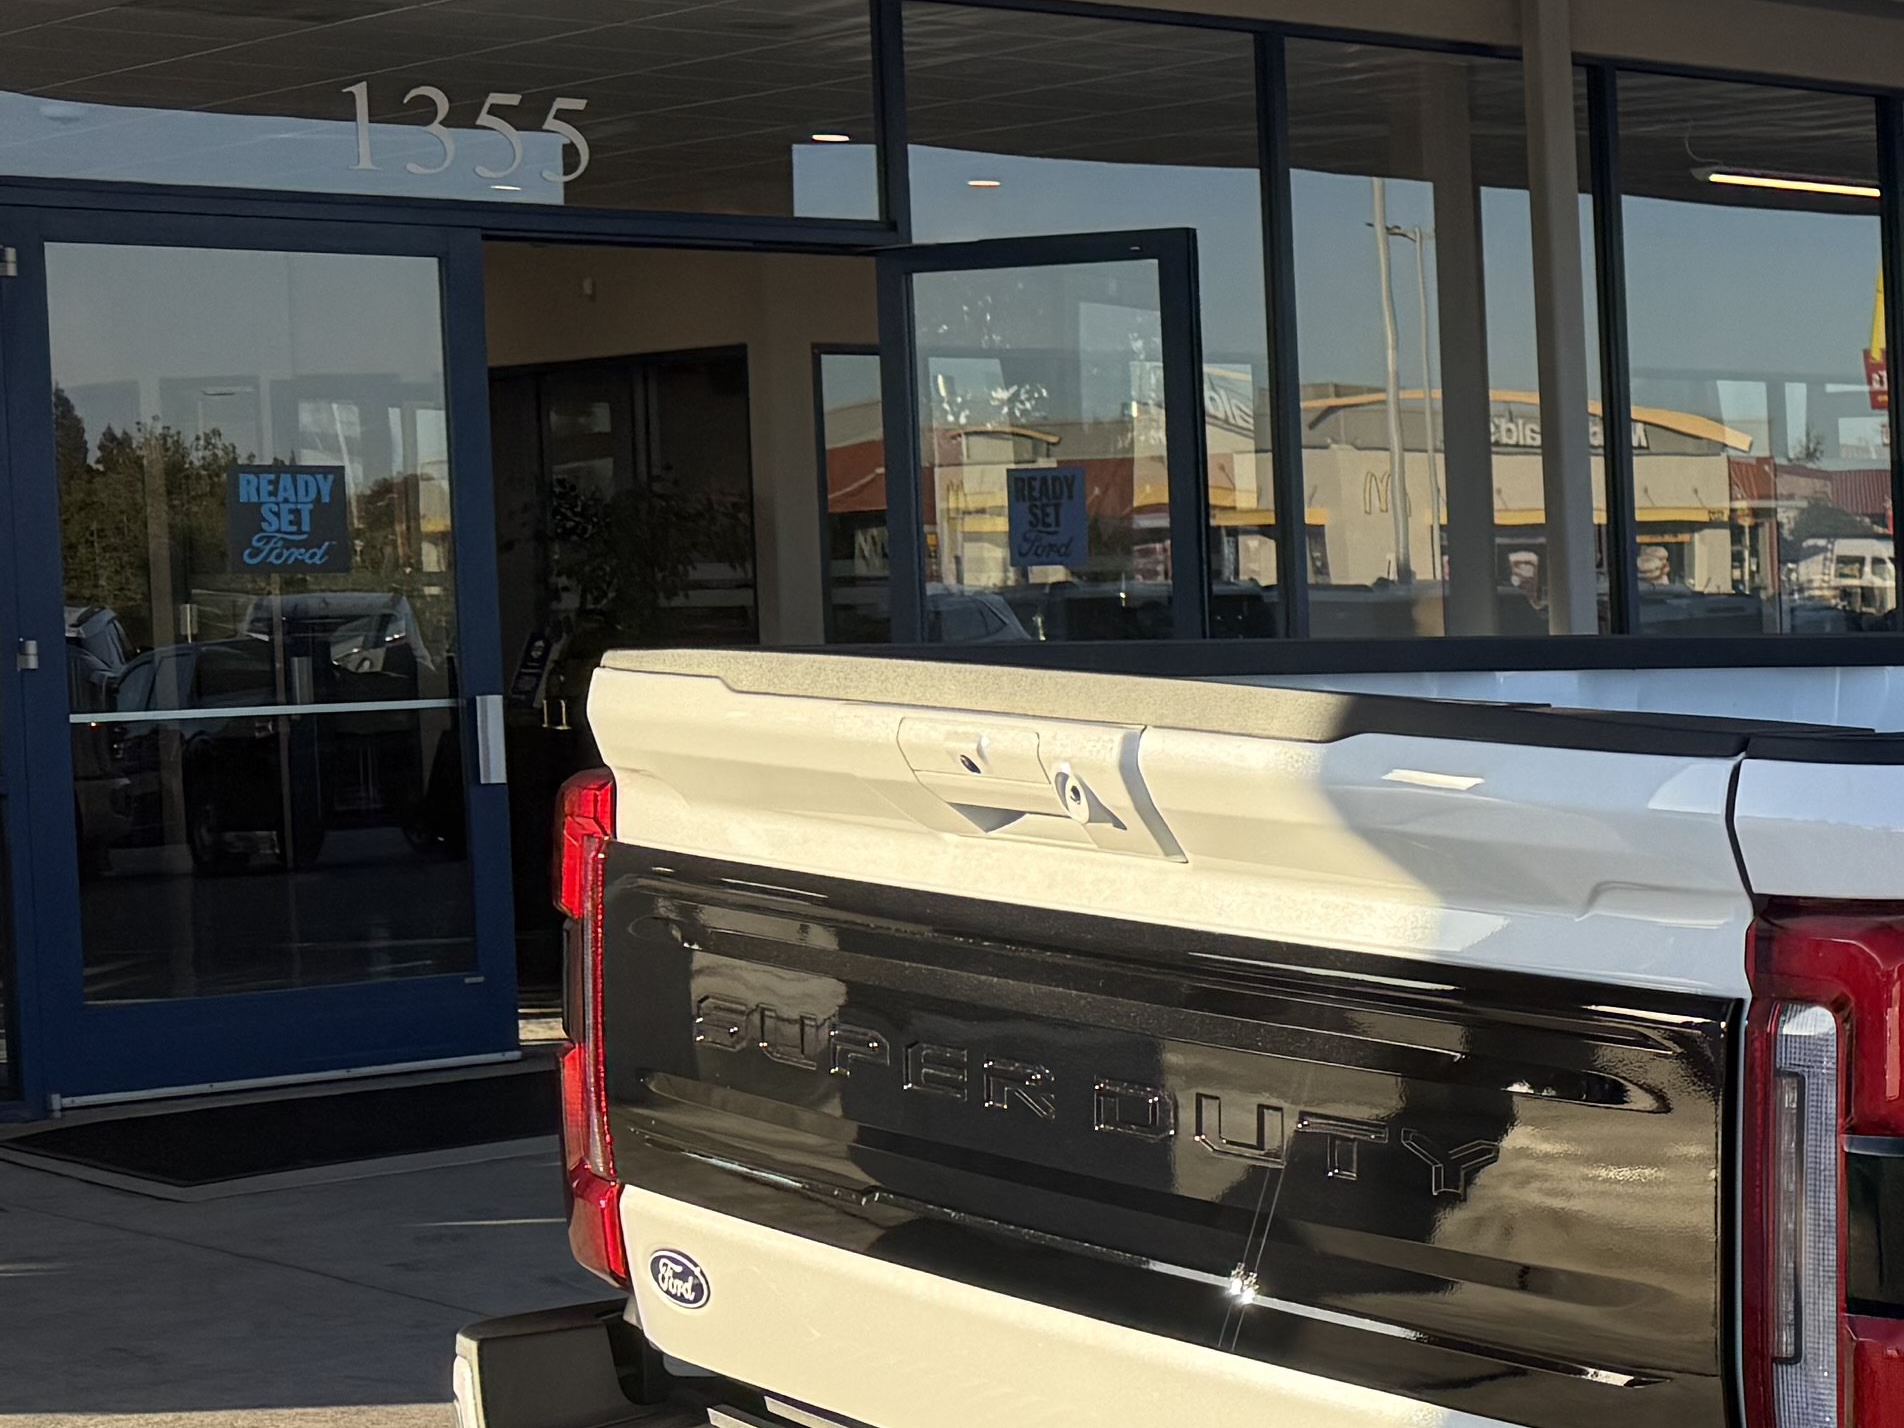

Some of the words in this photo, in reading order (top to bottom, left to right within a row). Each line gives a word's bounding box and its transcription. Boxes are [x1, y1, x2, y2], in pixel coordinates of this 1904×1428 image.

[341, 81, 590, 182] 1355
[239, 473, 334, 503] READY
[1014, 475, 1076, 502] READY
[261, 503, 314, 532] SET
[1028, 503, 1062, 528] SET
[243, 533, 330, 565] Ford
[1018, 529, 1074, 558] Ford
[695, 992, 1056, 1121] SUPER
[1093, 1075, 1500, 1197] DUTY
[657, 1257, 696, 1301] Ford
